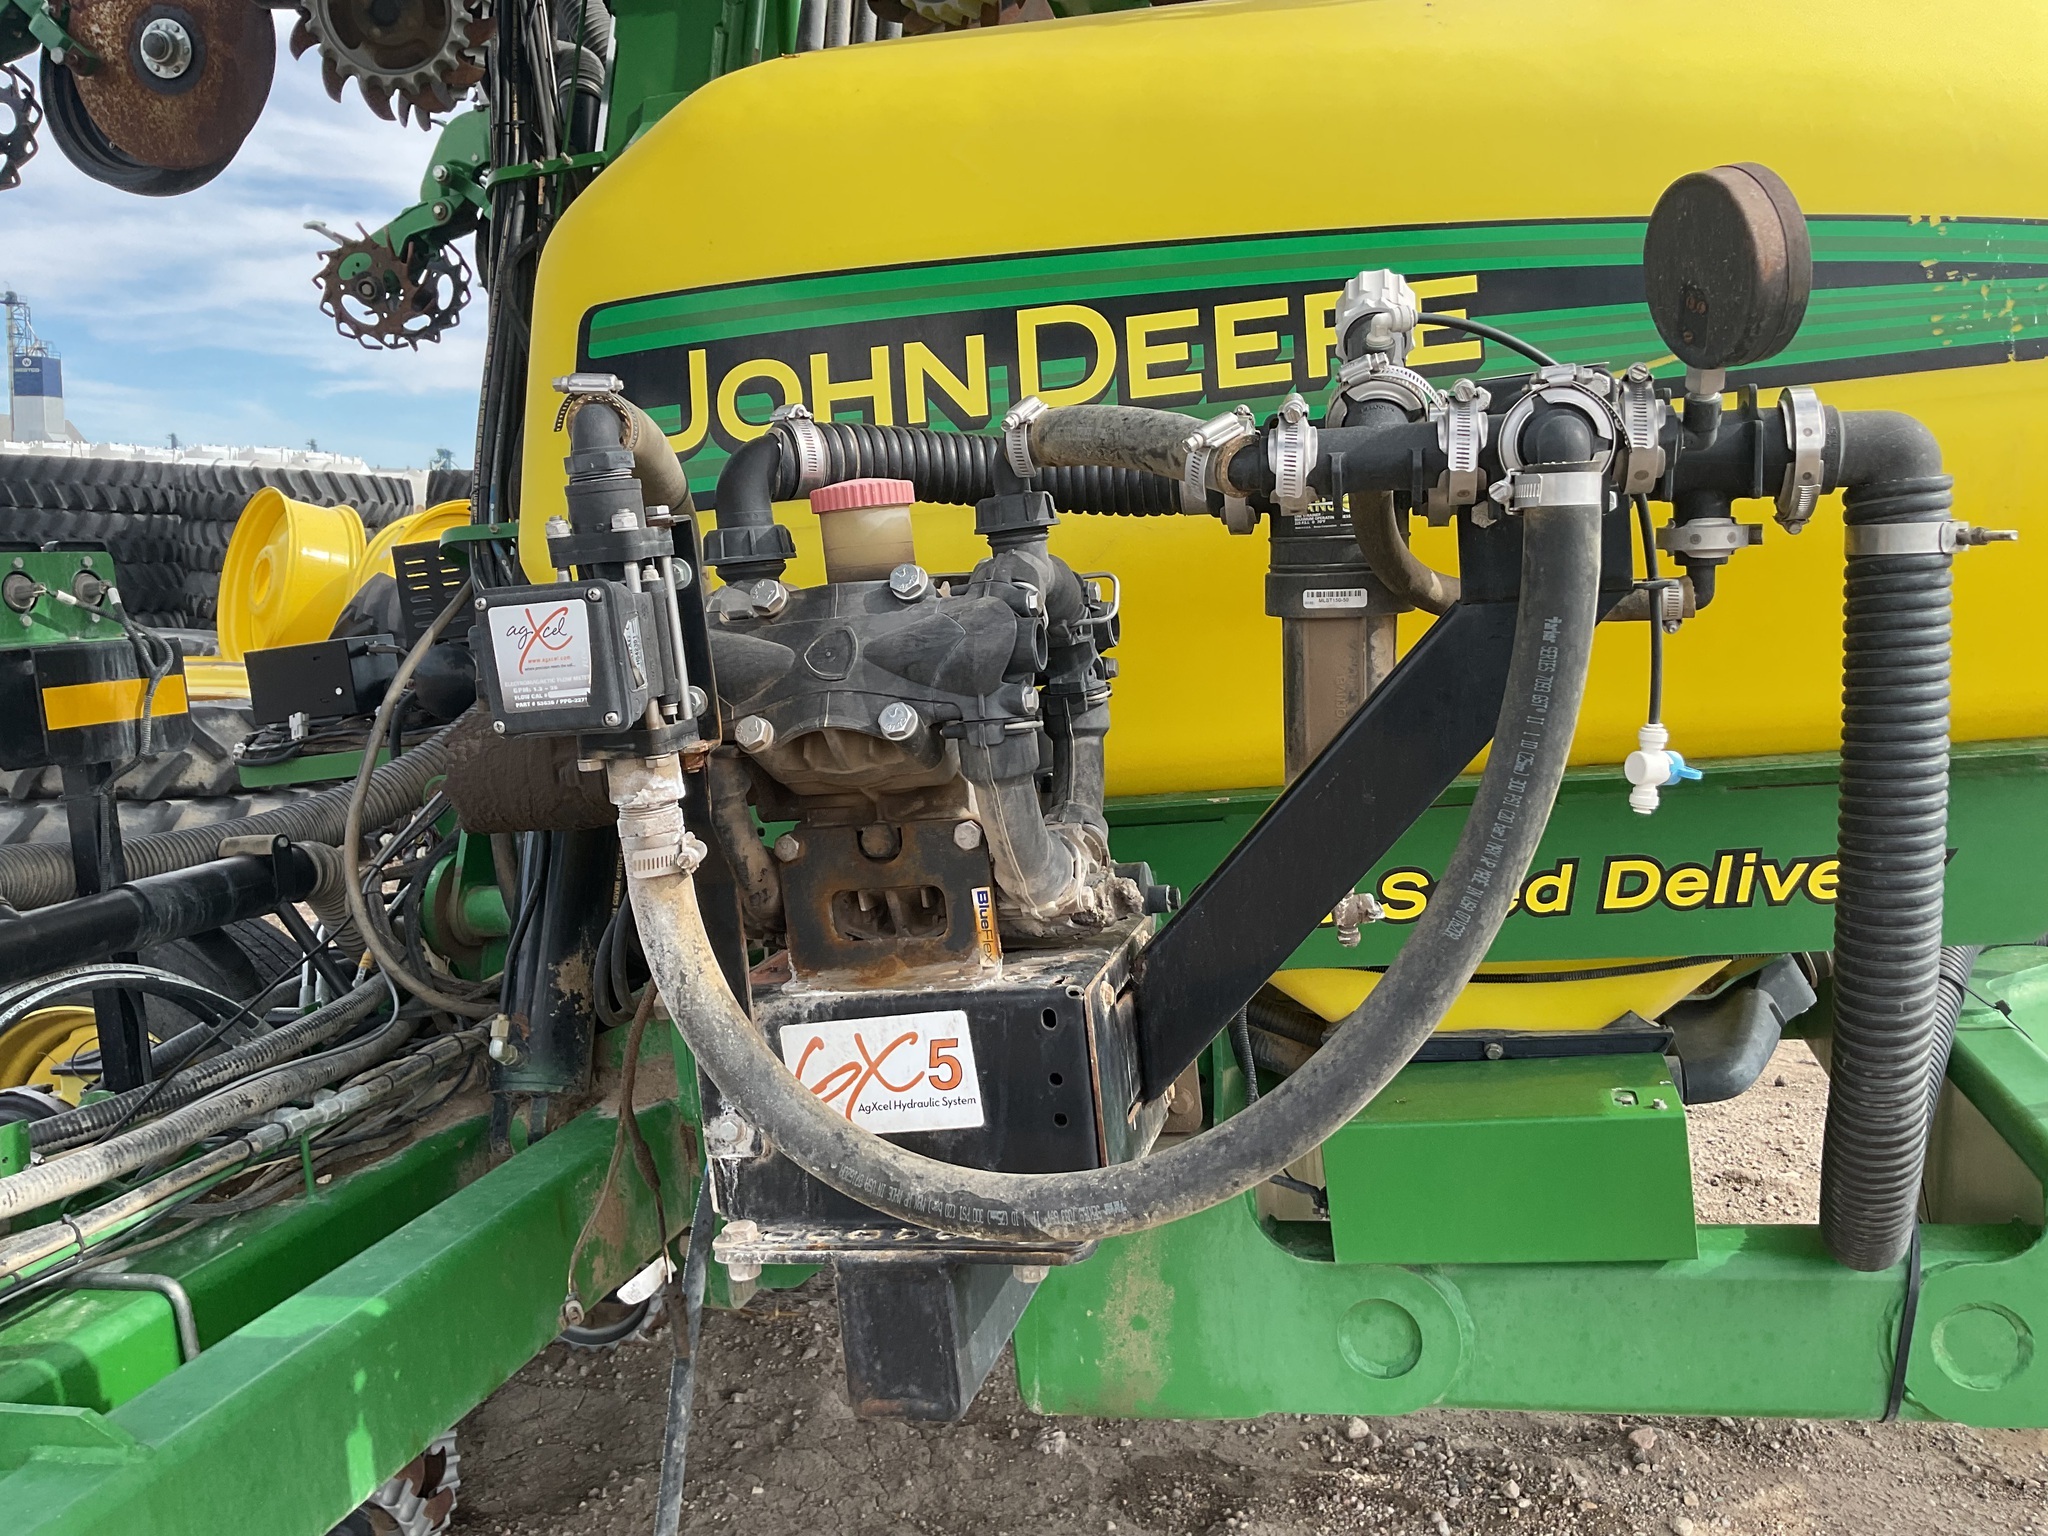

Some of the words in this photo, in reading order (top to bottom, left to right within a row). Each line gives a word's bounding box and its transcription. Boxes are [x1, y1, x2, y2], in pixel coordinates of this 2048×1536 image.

[667, 333, 988, 453] JOHN
[1538, 646, 1558, 672] SERIES
[514, 693, 530, 701] FLOW
[531, 692, 543, 700] CAL
[515, 701, 531, 709] PART
[1521, 739, 1538, 749] ID
[1507, 778, 1527, 793] 300
[1502, 792, 1522, 808] PSI
[1471, 866, 1493, 887] MADE
[1381, 864, 1573, 920] Sd
[1603, 852, 1840, 909] Delive
[1465, 885, 1484, 899] IN
[1459, 896, 1479, 912] USA
[977, 891, 993, 962] BlueFlex
[858, 1102, 892, 1115] AgXcel
[894, 1098, 940, 1113] Hydraulic
[942, 1095, 977, 1110] System
